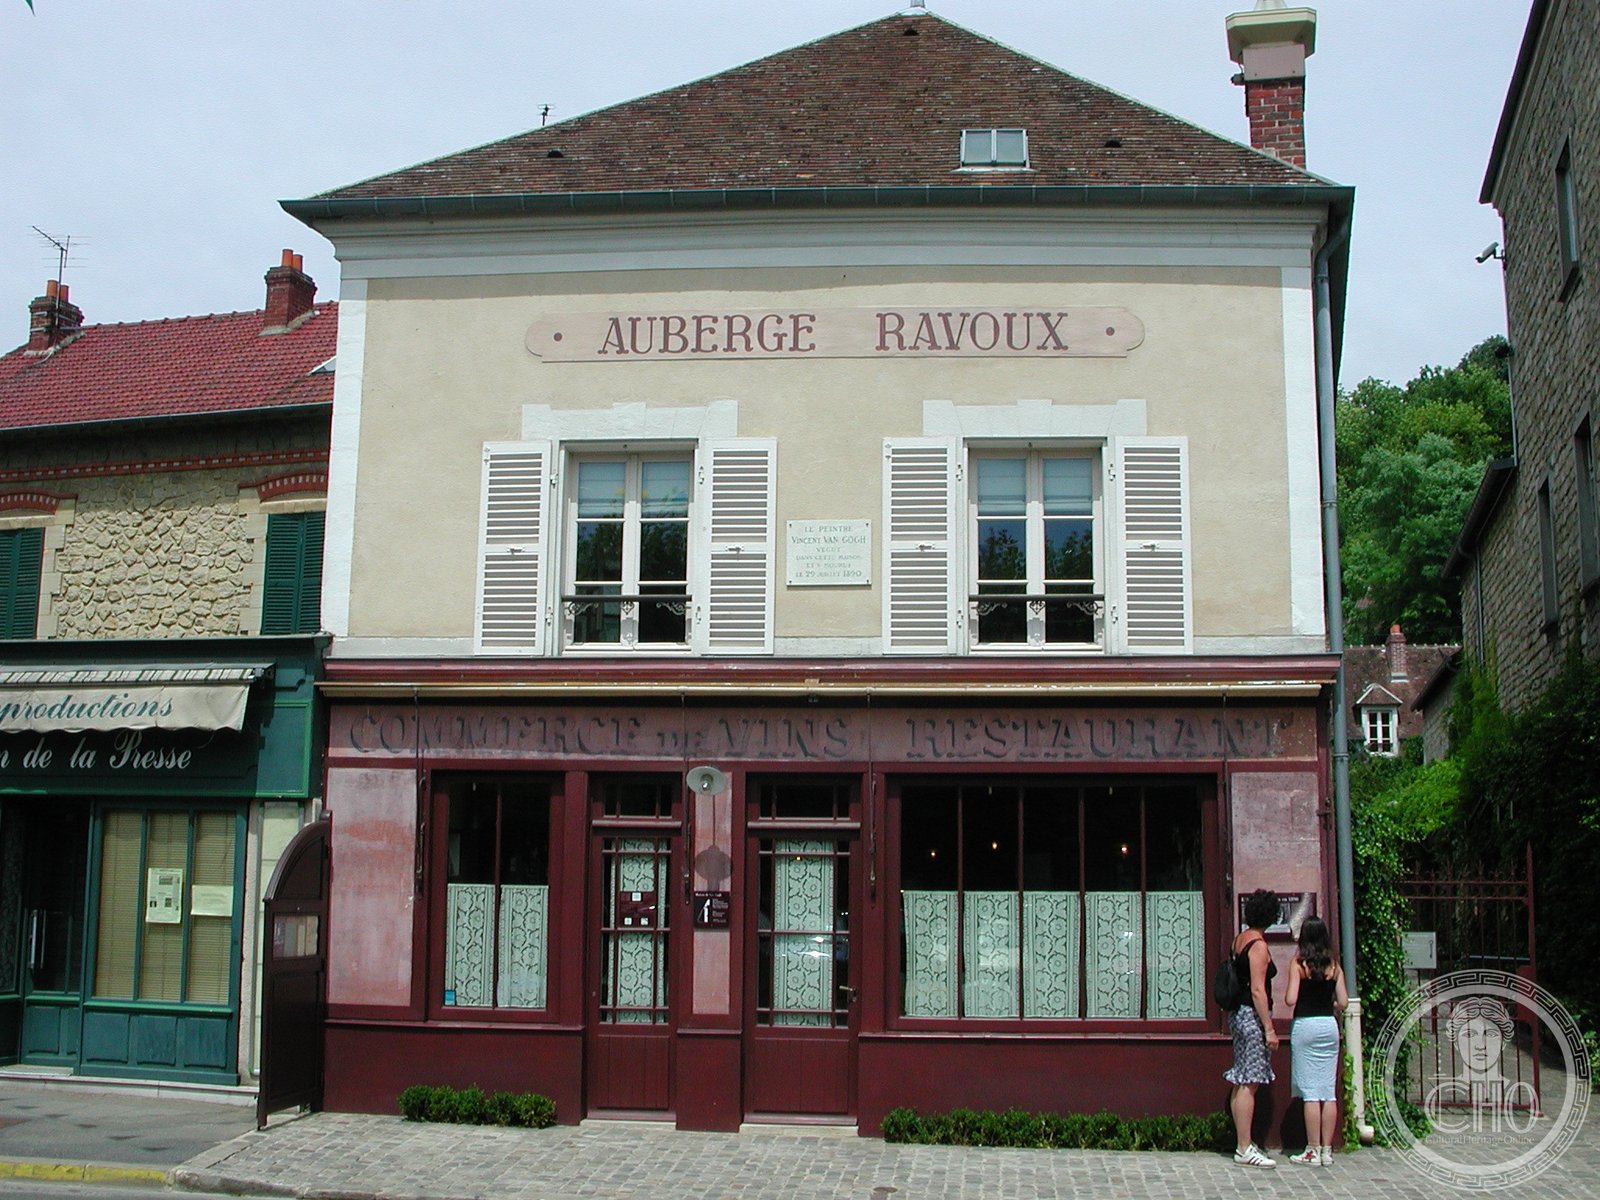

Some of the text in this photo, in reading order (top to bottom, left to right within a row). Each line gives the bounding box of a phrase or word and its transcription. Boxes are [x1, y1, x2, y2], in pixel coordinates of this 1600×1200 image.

[597, 311, 1069, 355] AUBERGE RAVOUX
[791, 535, 866, 544] VINCENT VAN GOGH
[0, 693, 173, 722] productions
[23, 737, 52, 768] de
[70, 737, 96, 768] la
[109, 729, 192, 769] Presse
[350, 714, 643, 758] COMMERCE
[717, 717, 849, 759] VINS
[906, 712, 1294, 759] RESTAURANT
